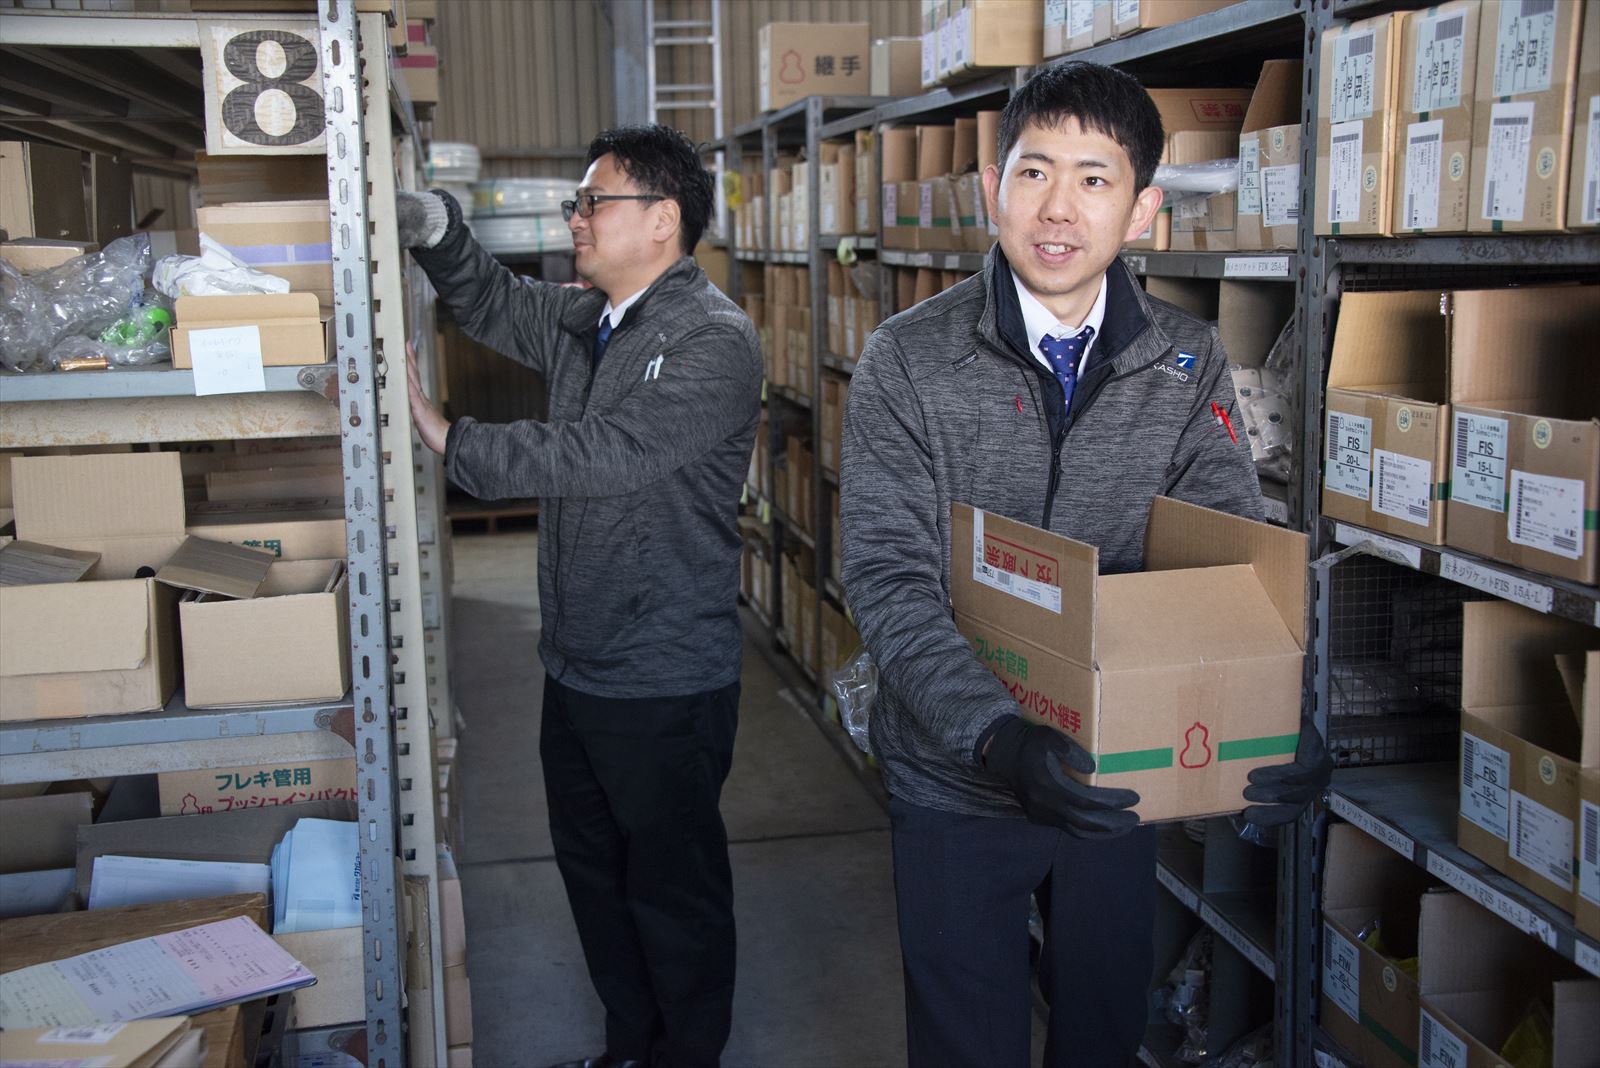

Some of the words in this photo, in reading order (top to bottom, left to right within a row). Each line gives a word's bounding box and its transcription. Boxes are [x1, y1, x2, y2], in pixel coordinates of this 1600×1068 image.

[1526, 38, 1538, 69] FIS
[814, 55, 861, 77] 継手
[1440, 59, 1450, 87] FIS
[221, 29, 326, 147] 8
[1354, 74, 1363, 100] FIS
[1347, 436, 1360, 450] FIS
[1478, 440, 1494, 456] FIS
[1346, 454, 1361, 467] 20-L
[1477, 461, 1494, 474] 15-L
[975, 637, 1028, 681] フレキ管用
[993, 670, 1082, 734] インパクト継手
[215, 767, 311, 791] フレキ管用
[1482, 765, 1498, 784] FIS
[1482, 784, 1498, 802] 15-L
